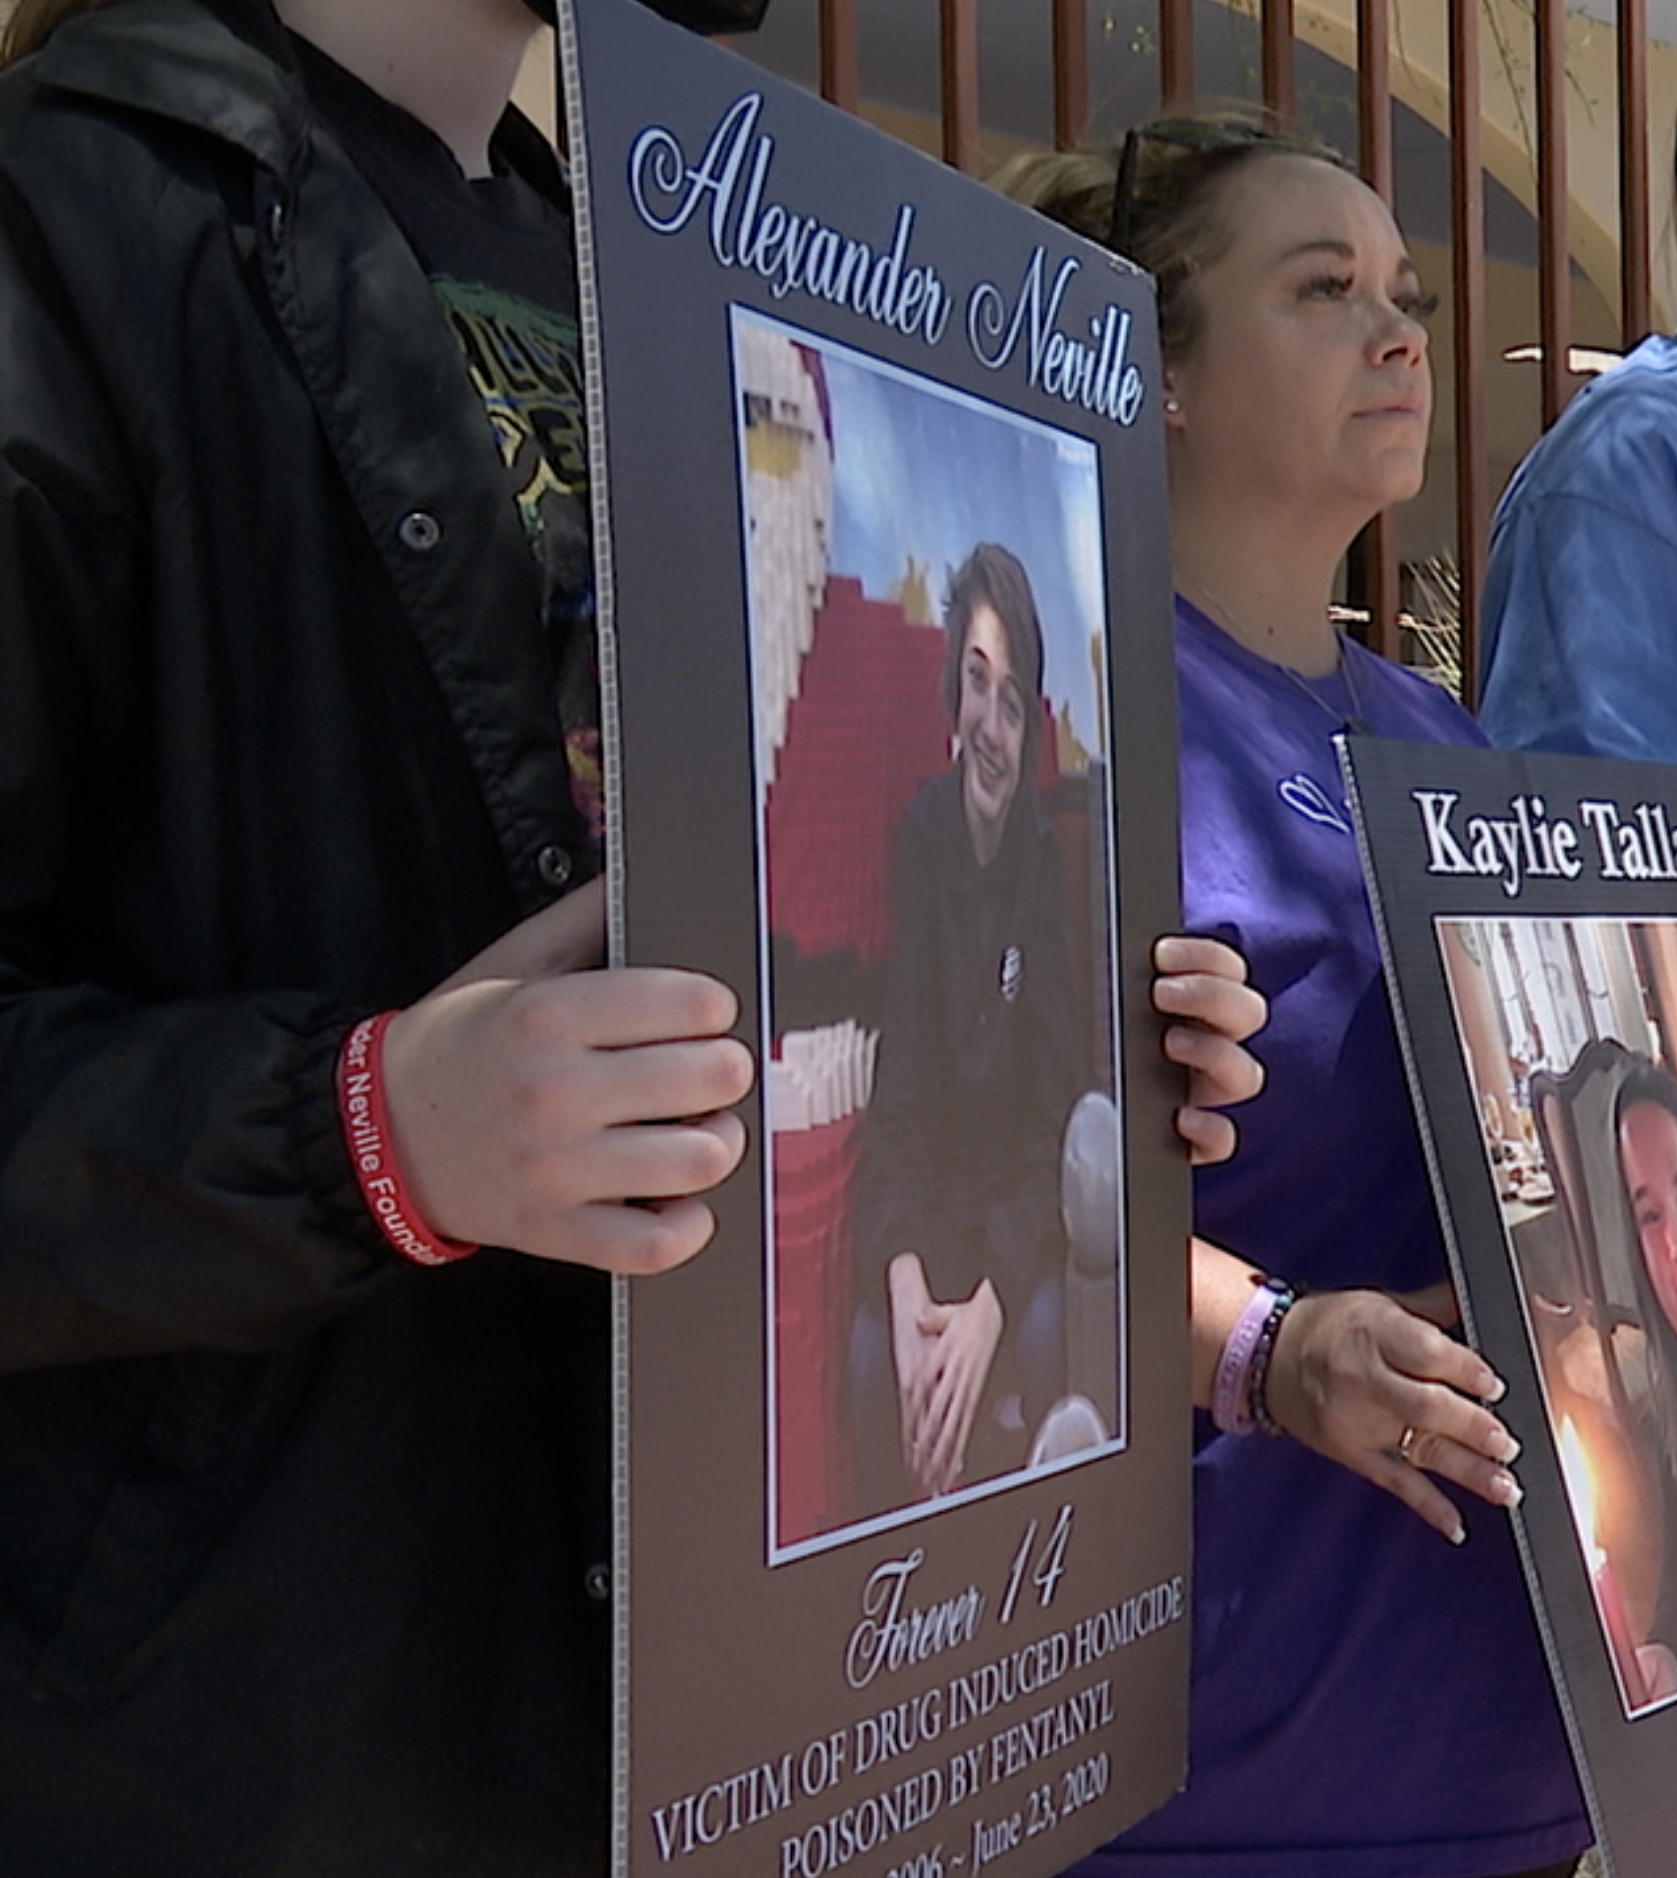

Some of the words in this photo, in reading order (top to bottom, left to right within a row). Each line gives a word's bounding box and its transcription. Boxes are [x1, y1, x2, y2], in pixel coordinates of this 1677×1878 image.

[629, 92, 951, 346] Alexander
[969, 246, 1143, 427] Neville
[1412, 791, 1582, 897] Kaylie
[346, 1073, 383, 1173] Neville
[846, 1548, 986, 1689] Forever
[1001, 1504, 1072, 1624] 14
[652, 1752, 792, 1862] VICTIM
[800, 1730, 846, 1796] OF
[855, 1689, 941, 1775] DRUG
[949, 1634, 1068, 1728] INDUCED
[1075, 1577, 1185, 1662] HOMICIDE
[781, 1768, 943, 1878] POISONED
[949, 1745, 985, 1809] BY
[990, 1681, 1114, 1783] FENTANYL
[972, 1813, 1022, 1877] June
[1026, 1783, 1056, 1837] 23,
[1062, 1755, 1109, 1815] 2020
